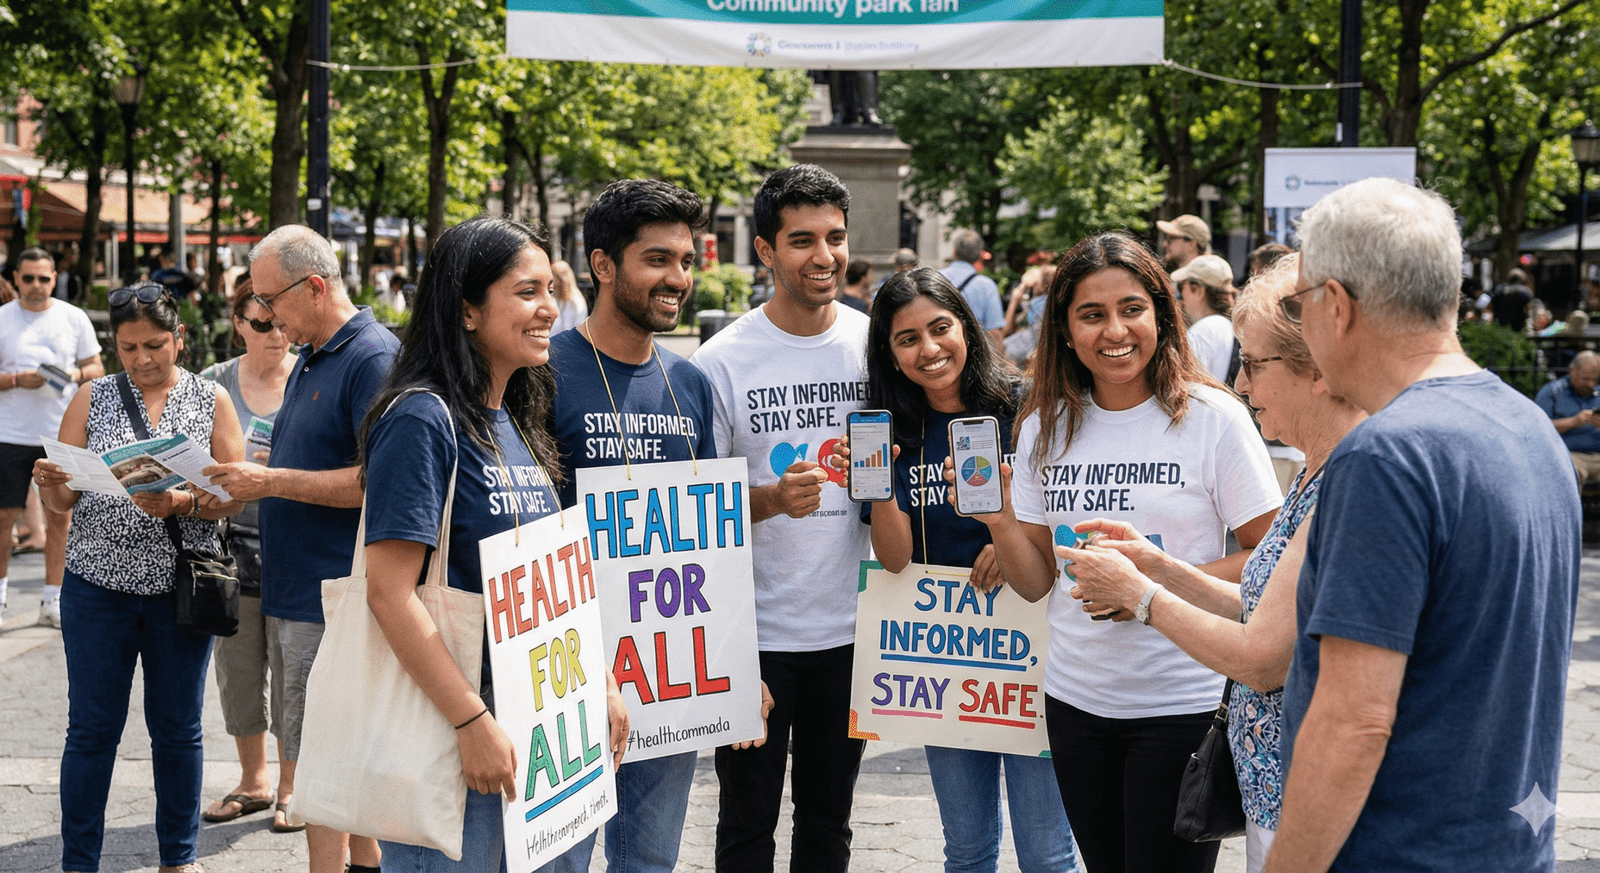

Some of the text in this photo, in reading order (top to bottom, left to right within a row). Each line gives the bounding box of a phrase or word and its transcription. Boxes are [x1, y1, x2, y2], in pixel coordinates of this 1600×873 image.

[855, 0, 913, 18] park
[747, 386, 787, 410] STAY
[584, 413, 697, 440] STAY INFORMED,
[750, 406, 841, 434] STAY SAFE.
[585, 437, 667, 460] STAY SAFE.
[483, 465, 554, 488] STAY INFORM
[909, 462, 945, 485] STAY
[1041, 462, 1186, 488] STAY INFORMED,
[489, 491, 552, 516] STAY SAFE.
[910, 485, 946, 507] STAY
[1043, 488, 1135, 512] STAY SAFE.
[585, 481, 744, 561] HEALTH
[488, 536, 596, 644] HEALTH
[628, 563, 711, 623] FOR
[914, 578, 1003, 617] STAY
[880, 620, 1038, 666] INFORMED,
[529, 628, 587, 712] FOR
[612, 626, 731, 705] ALL
[871, 672, 1044, 718] STAY SAFE.
[525, 699, 602, 802] ALL
